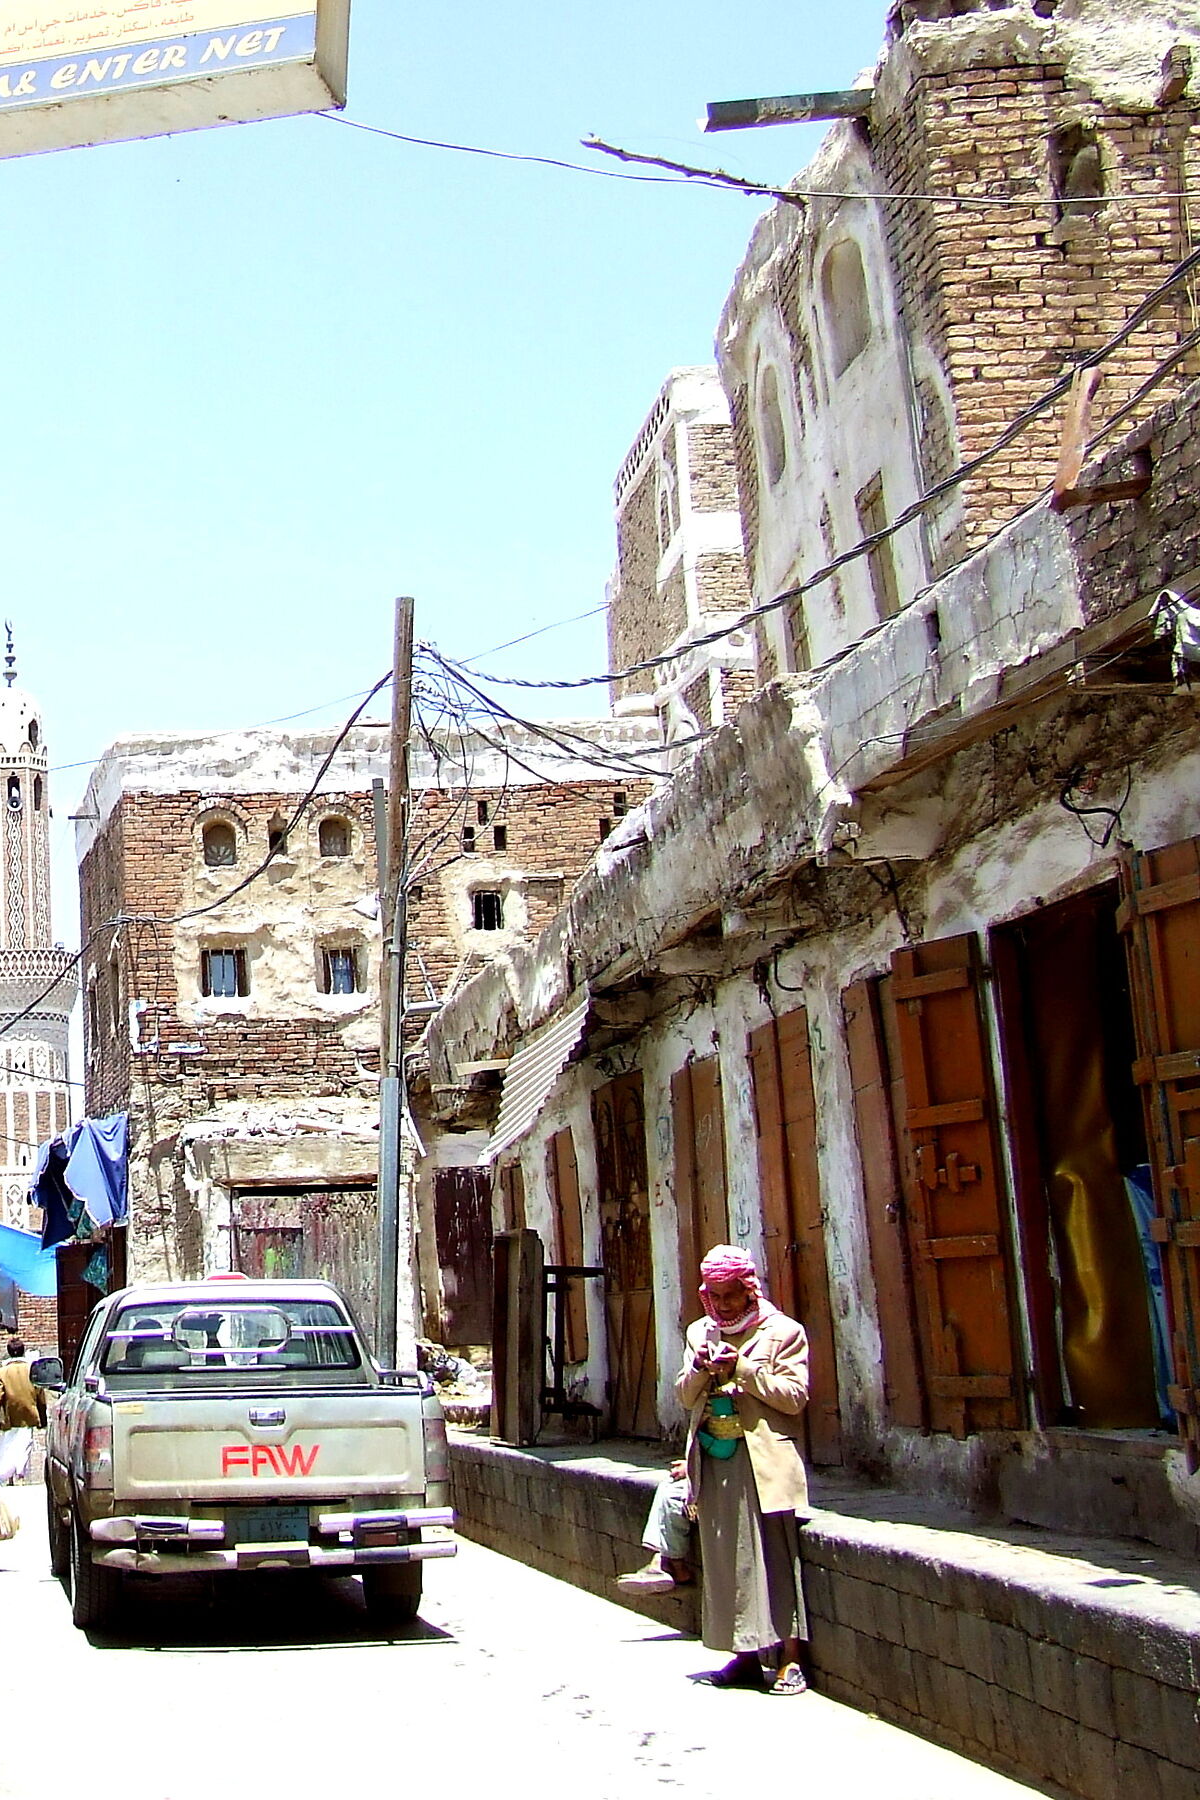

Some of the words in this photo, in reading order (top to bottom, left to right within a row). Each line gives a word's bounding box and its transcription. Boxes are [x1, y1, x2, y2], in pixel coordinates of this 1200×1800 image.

[51, 45, 187, 90] ENTER
[200, 27, 286, 64] NET
[221, 1444, 320, 1477] FAW
